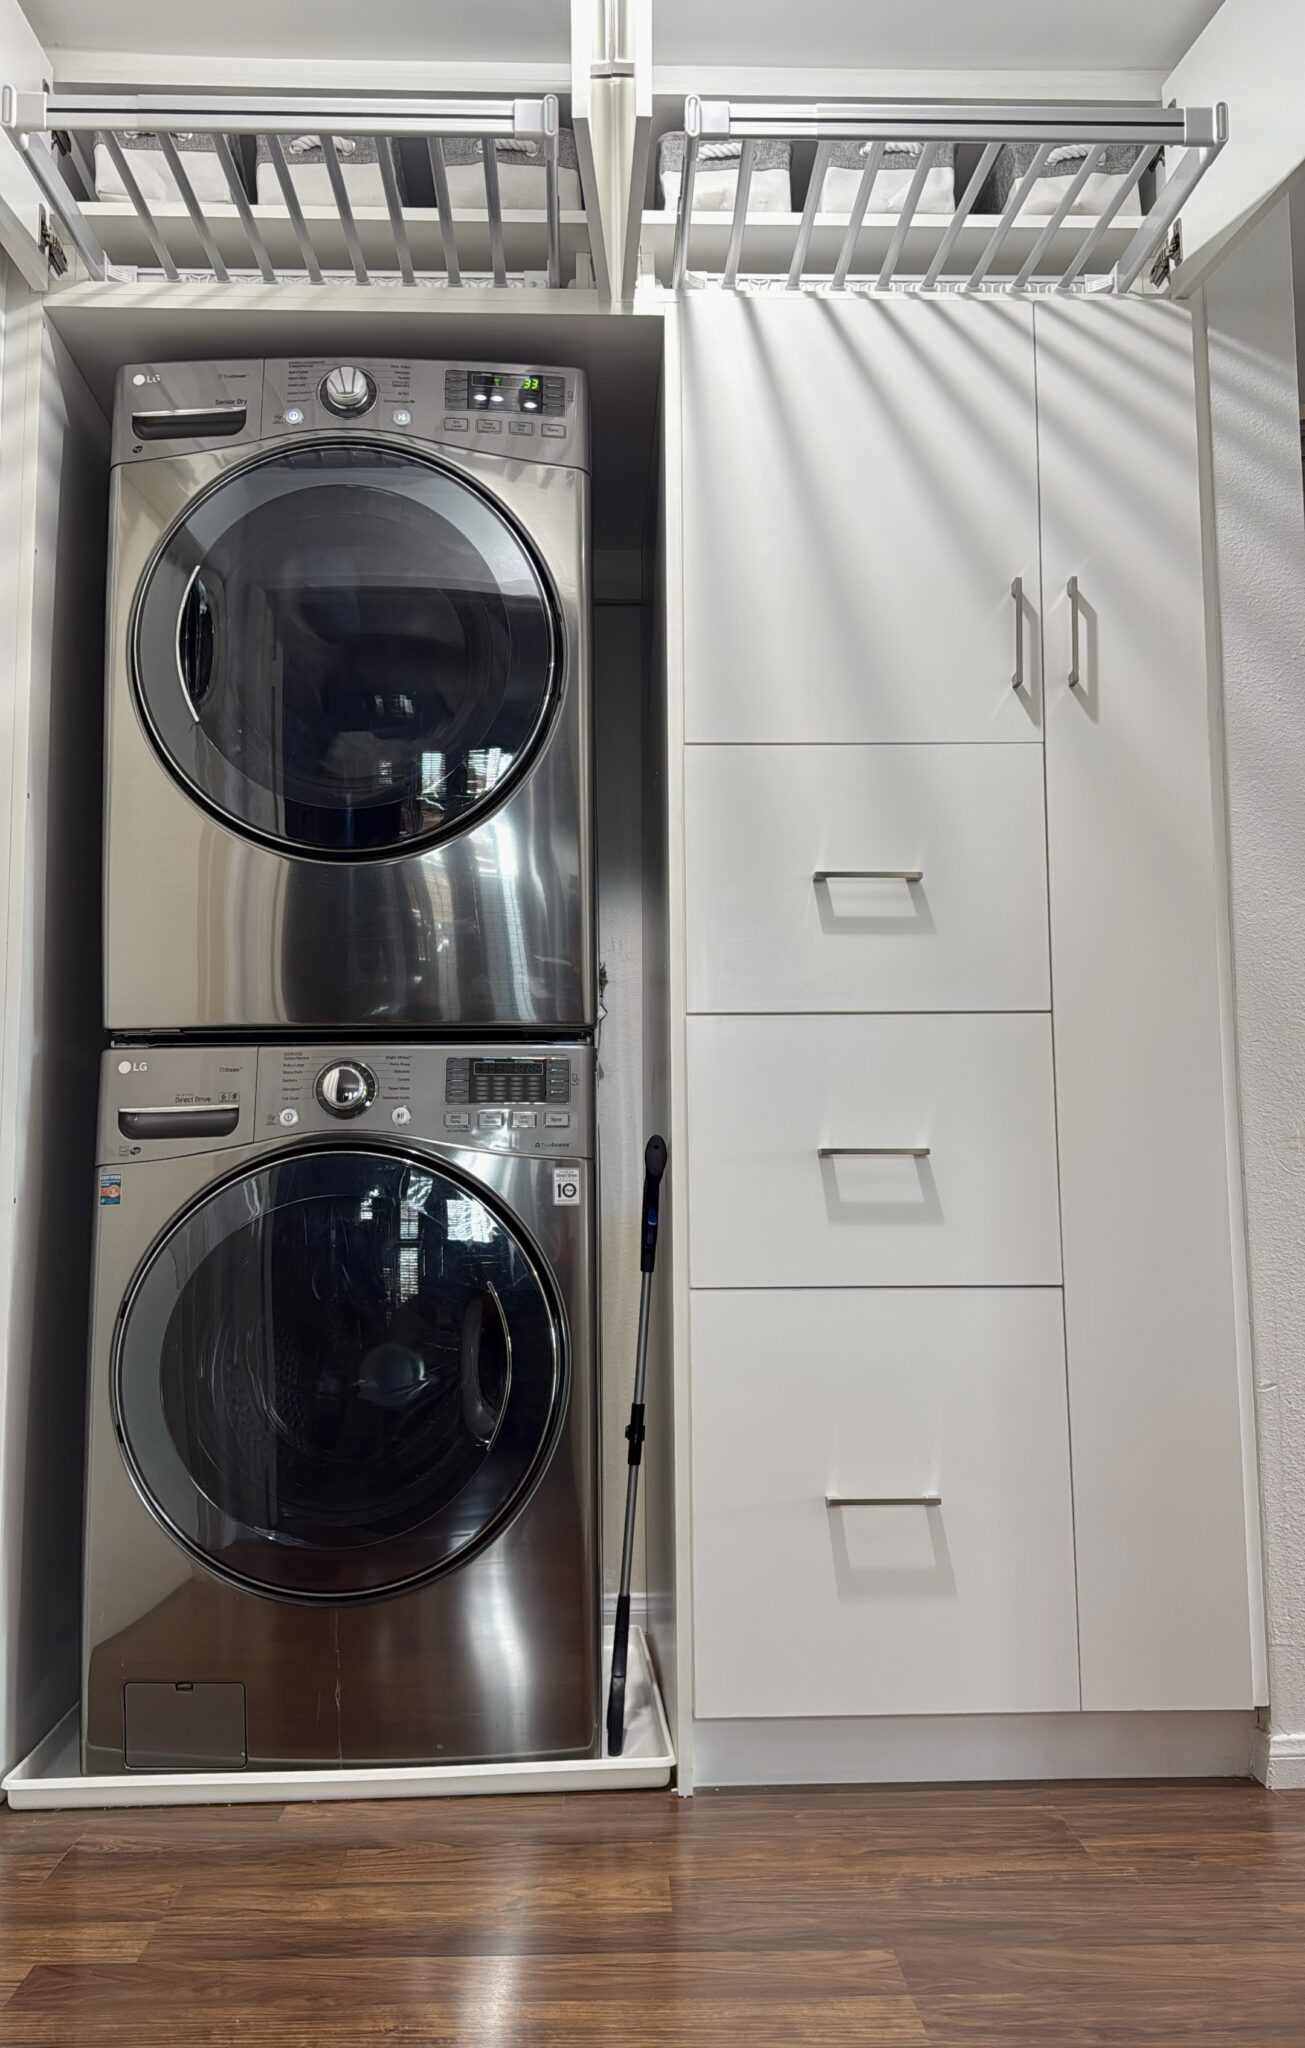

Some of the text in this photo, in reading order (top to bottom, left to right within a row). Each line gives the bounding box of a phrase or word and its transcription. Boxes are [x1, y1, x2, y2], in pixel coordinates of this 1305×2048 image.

[146, 374, 161, 384] LG
[523, 378, 539, 390] 33
[236, 398, 248, 407] Dry
[132, 1062, 148, 1072] LG
[175, 1096, 194, 1104] Direct
[557, 1183, 577, 1198] 10
